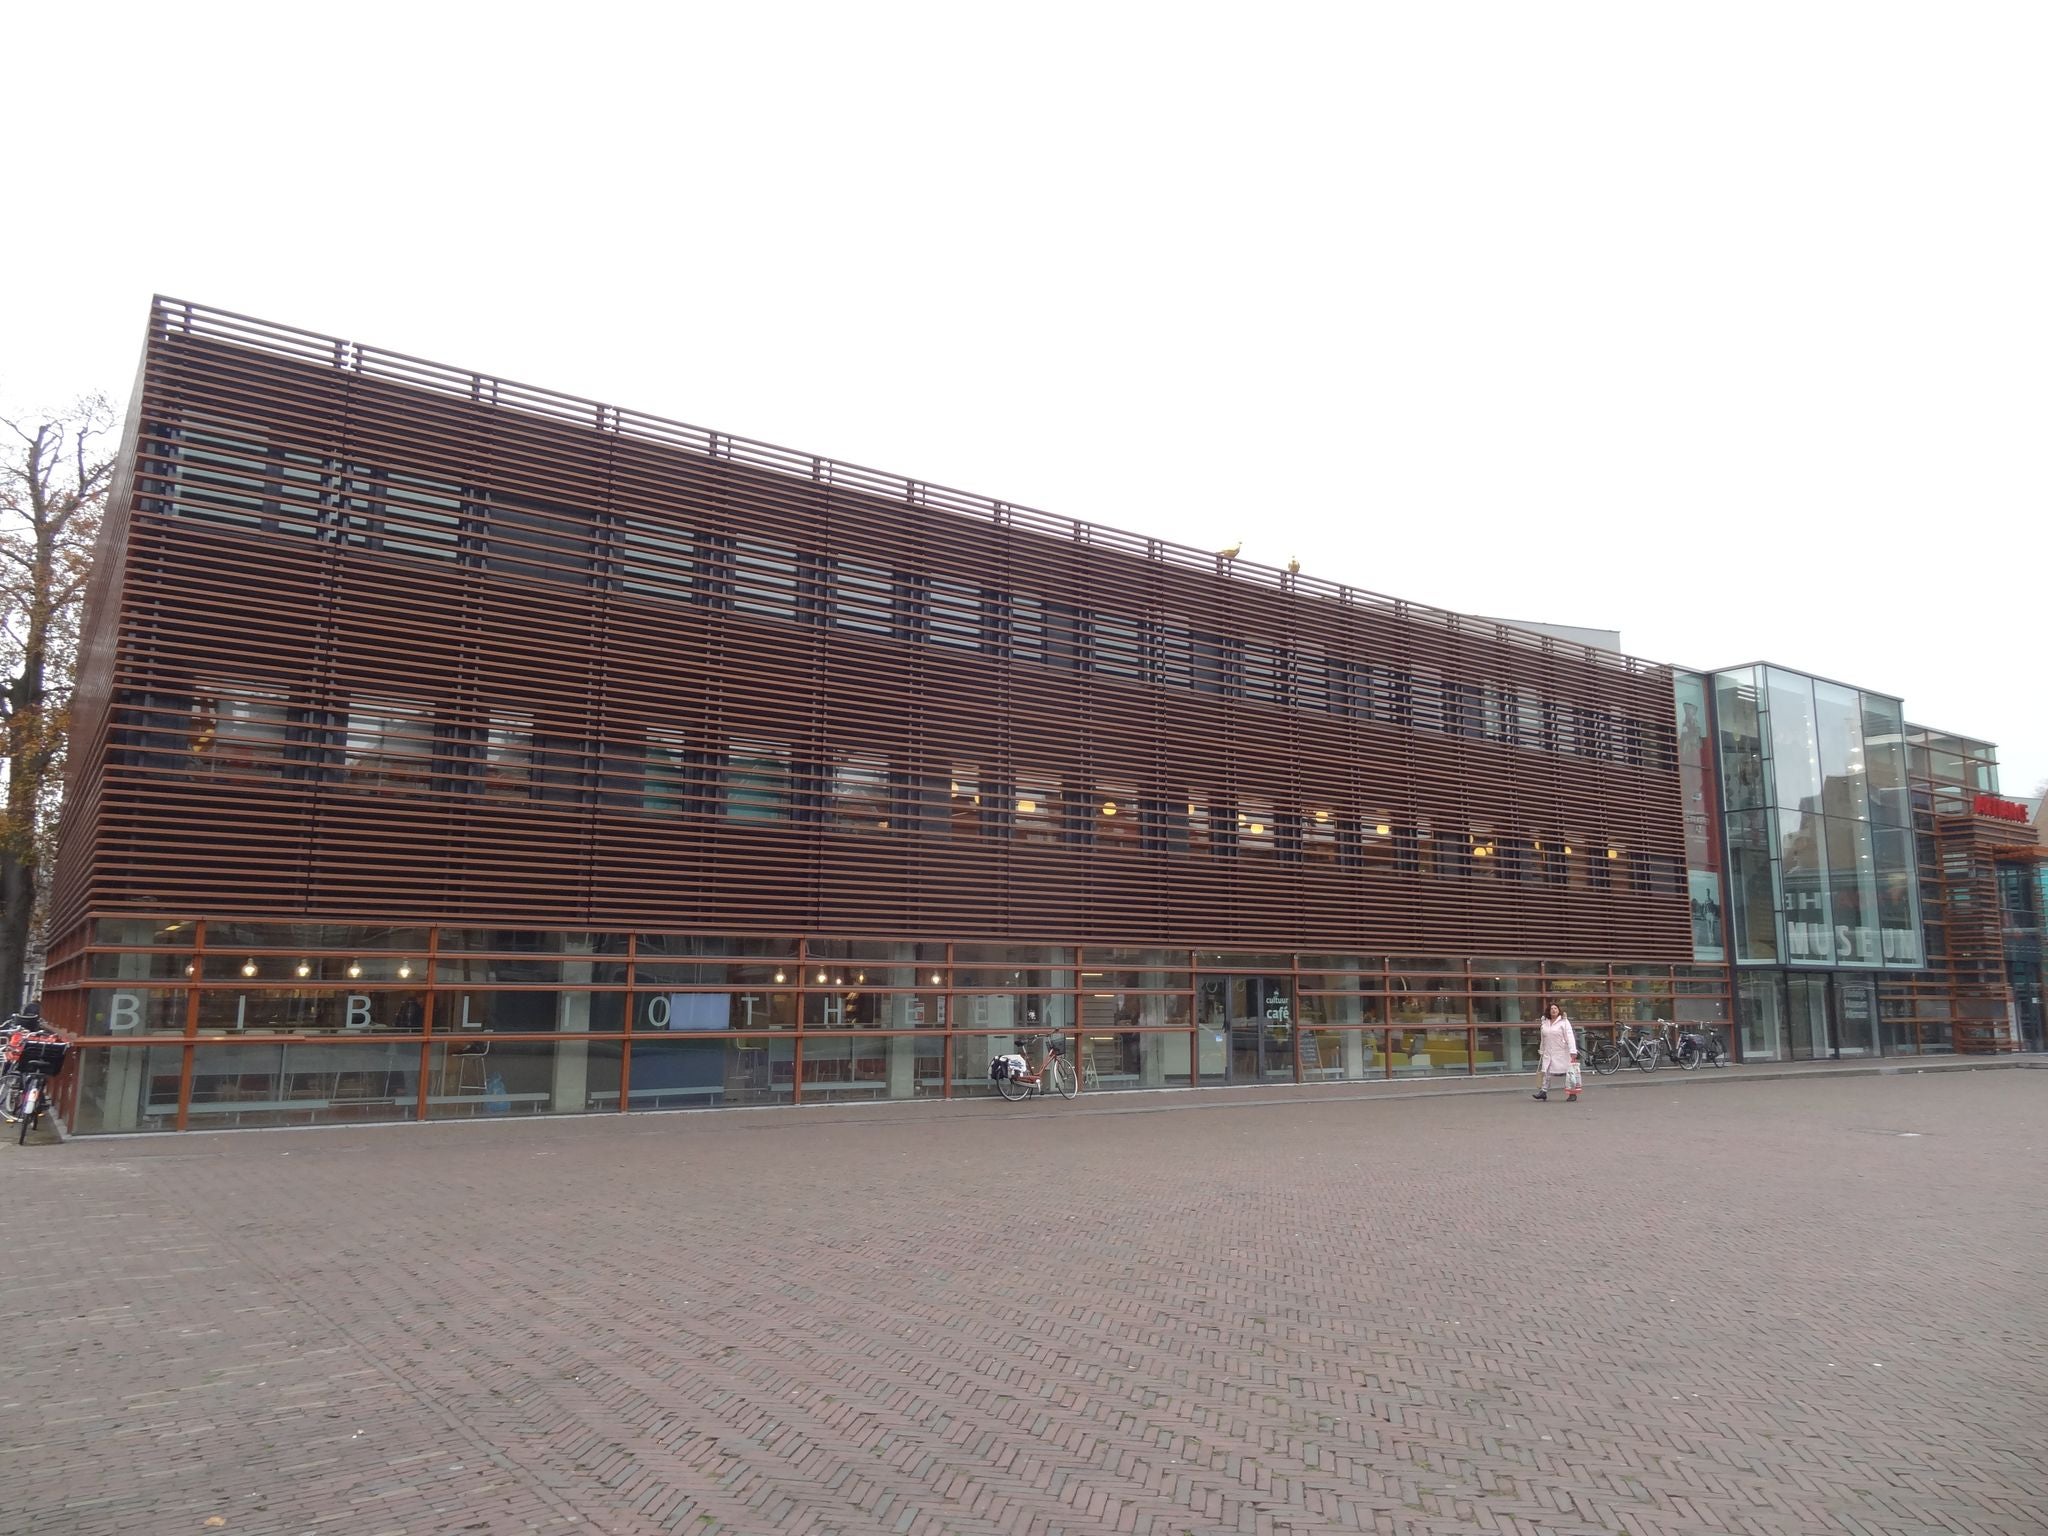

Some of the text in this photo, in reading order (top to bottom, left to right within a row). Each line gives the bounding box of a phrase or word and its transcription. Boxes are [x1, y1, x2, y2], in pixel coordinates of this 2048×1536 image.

[1787, 920, 1917, 959] MUSEUM
[1265, 996, 1289, 1004] cultuur
[1266, 1006, 1290, 1022] café
